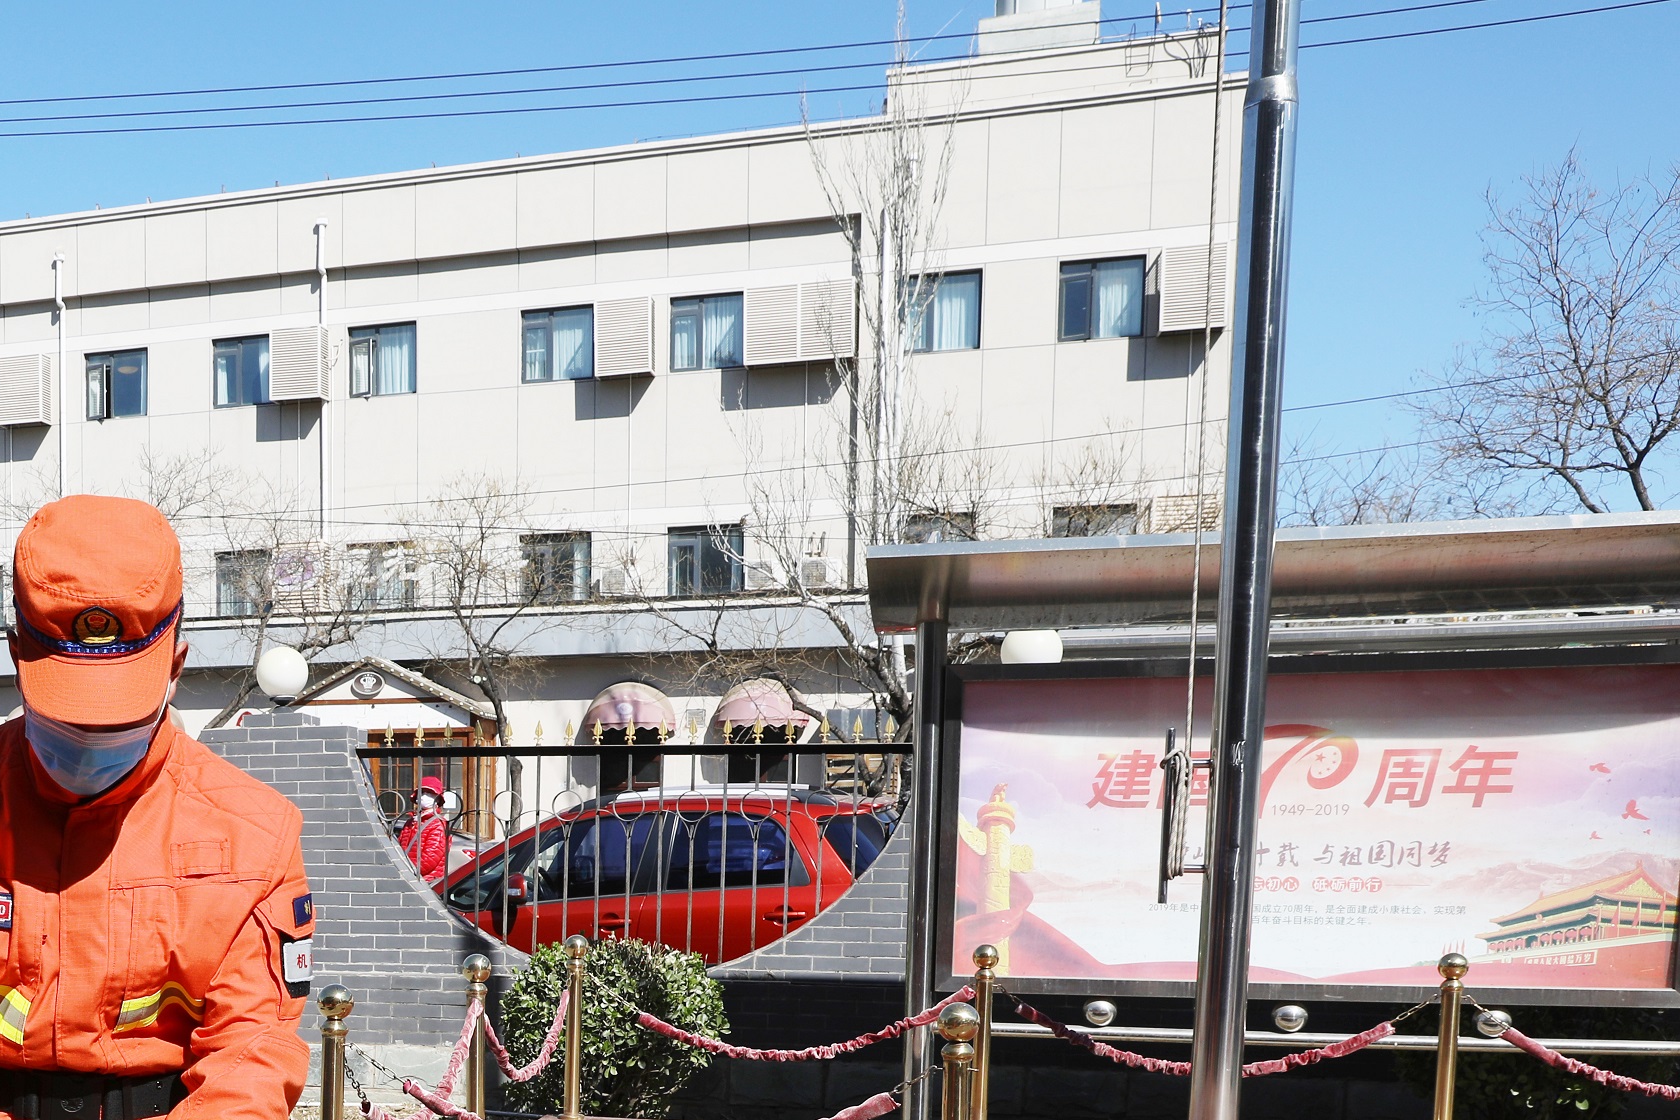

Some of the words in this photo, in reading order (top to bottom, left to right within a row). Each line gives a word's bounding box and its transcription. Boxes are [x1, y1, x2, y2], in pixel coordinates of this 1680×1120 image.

[1271, 803, 1350, 816] 1949-2019
[1253, 877, 1299, 892] 忘初心
